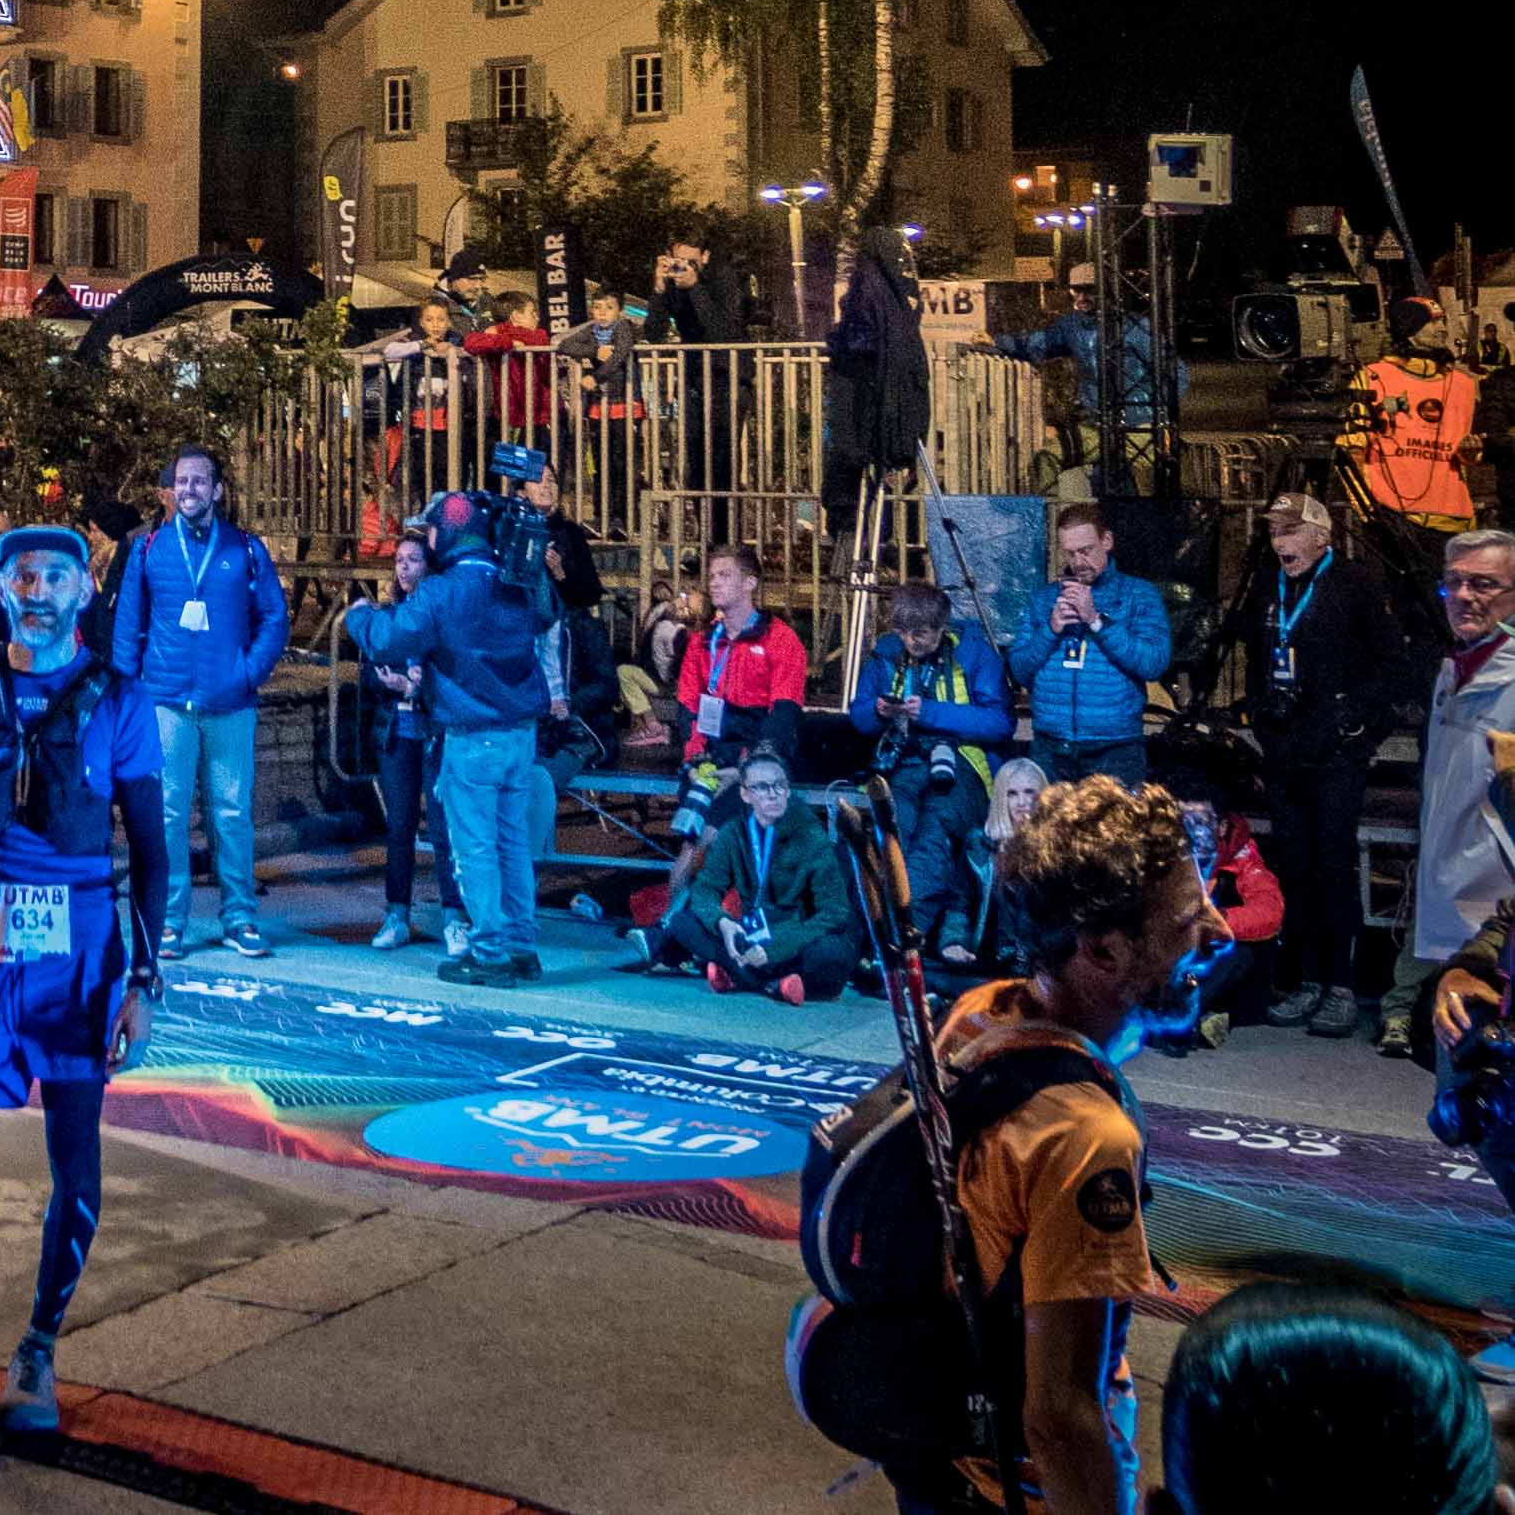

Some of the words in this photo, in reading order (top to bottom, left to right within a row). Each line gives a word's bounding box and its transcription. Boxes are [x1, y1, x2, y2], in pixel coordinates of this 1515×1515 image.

[544, 232, 567, 285] BAR
[183, 271, 240, 284] TRAILERS
[190, 282, 229, 294] MONT
[231, 281, 274, 294] BLANC
[69, 285, 123, 310] Tour
[547, 291, 570, 334] BEL
[919, 286, 974, 315] MB
[4, 885, 63, 905] UTMB
[11, 908, 54, 931] 634
[602, 1066, 807, 1107] Columbia
[689, 1052, 880, 1091] UTMB
[483, 1098, 761, 1155] UTMB
[1187, 1125, 1341, 1157] CCC
